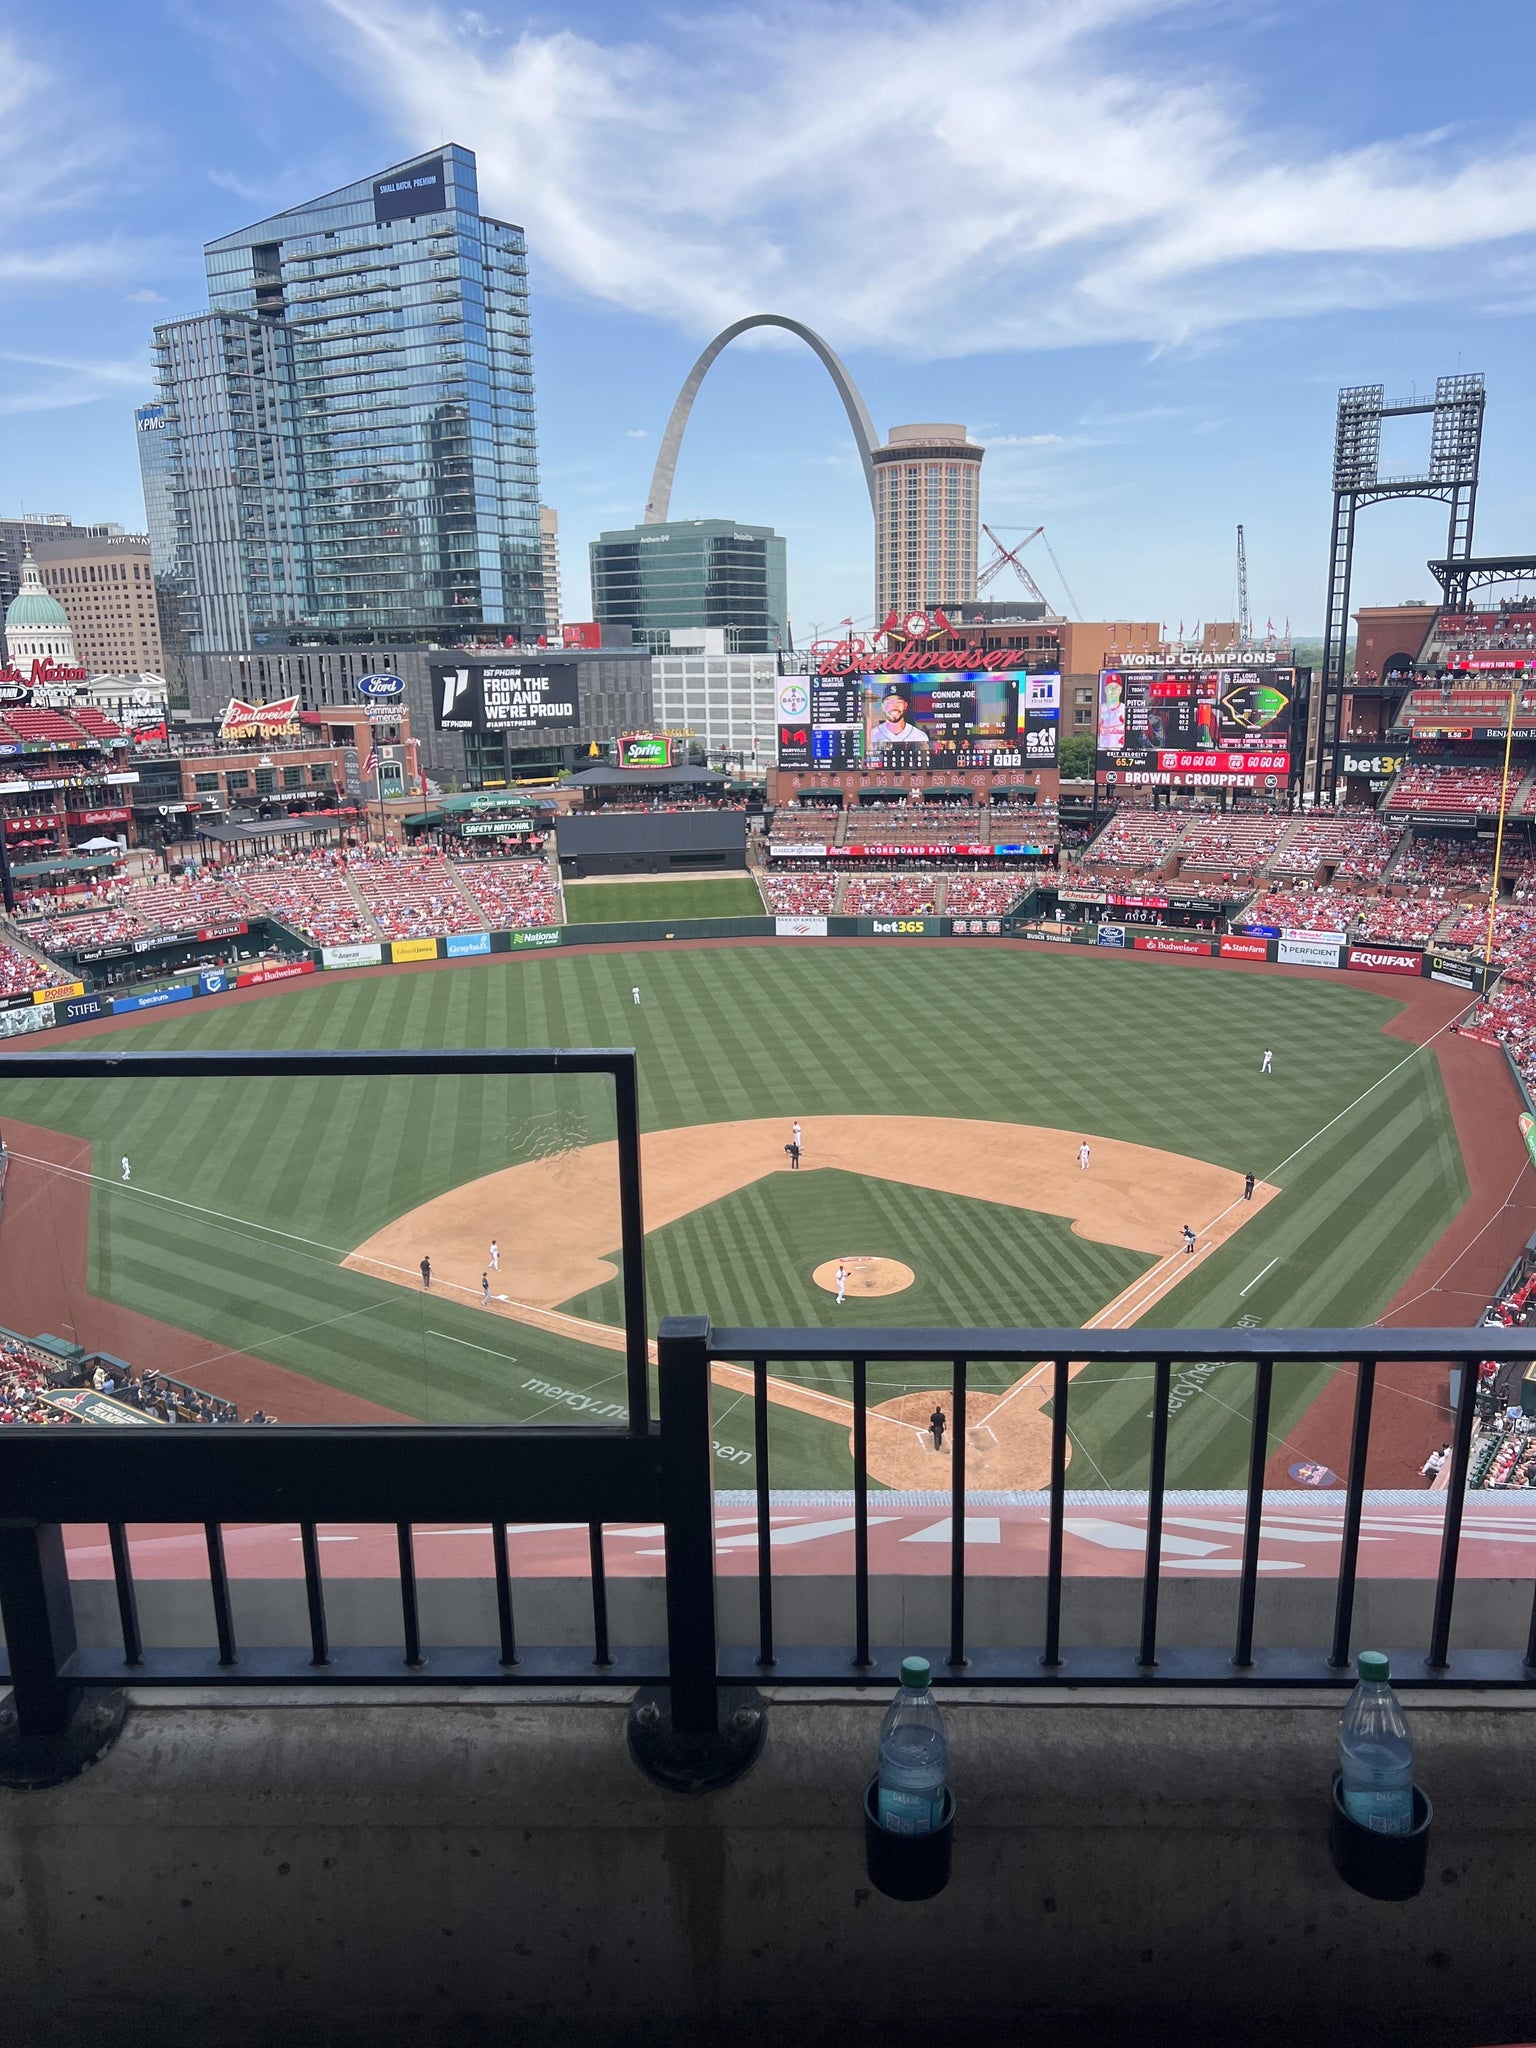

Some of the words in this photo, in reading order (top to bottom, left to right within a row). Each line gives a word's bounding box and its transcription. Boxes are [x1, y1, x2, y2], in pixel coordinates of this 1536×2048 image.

[380, 184, 396, 194] SMALL
[414, 176, 436, 187] PREMIUM
[138, 416, 164, 432] KPMG
[107, 537, 125, 545] HYATT
[811, 639, 1025, 676] Budweiser
[1120, 654, 1176, 666] WORLD
[1180, 652, 1276, 664] CHAMPIONS
[24, 656, 87, 687] Nation
[368, 677, 396, 692] Ford
[484, 679, 522, 691] FROM
[524, 678, 550, 690] THE
[33, 688, 77, 697] ROOFTOP
[485, 692, 512, 705] LOU
[513, 691, 541, 704] AND
[219, 708, 299, 724] Budweiser
[364, 706, 406, 716] Community
[485, 706, 523, 719] WE'RE
[526, 703, 572, 716] PROUD
[451, 720, 472, 728] PHORM
[222, 726, 257, 739] BREW
[260, 723, 300, 737] HOUSE
[628, 744, 661, 757] Sprite
[1180, 756, 1192, 766] GO
[1193, 756, 1203, 766] GO
[1205, 756, 1216, 766] GO
[1248, 757, 1258, 767] GO
[1260, 757, 1272, 767] GO
[1273, 757, 1284, 768] GO
[810, 778, 816, 787] 1
[821, 778, 828, 787] 2
[833, 778, 840, 787] 6
[846, 777, 854, 786] 9
[860, 777, 870, 786] 10
[877, 776, 887, 786] 14
[894, 776, 904, 786] 17
[910, 776, 924, 786] 20
[932, 776, 945, 786] 23
[952, 775, 965, 786] 24
[972, 775, 985, 785] 42
[992, 775, 1006, 785] 45
[1011, 774, 1024, 785] 85
[1125, 772, 1170, 784] BROWN
[1174, 776, 1181, 784] &
[1185, 773, 1254, 786] CROUPPEN
[466, 825, 493, 833] SAFETY
[494, 823, 530, 831] NATIONAL
[968, 846, 990, 854] Coca-Cola
[214, 926, 238, 935] PURINA
[873, 921, 924, 932] bet365
[1102, 927, 1119, 936] Ford
[524, 931, 558, 942] National
[1158, 942, 1198, 952] Budweiser
[1290, 947, 1337, 956] PERFICIENT
[1350, 952, 1415, 968] EQUIFAX
[201, 969, 224, 978] CarShield
[264, 968, 302, 981] Budweiser
[45, 986, 74, 997] DOBBS
[139, 995, 167, 1006] Spectrum
[68, 1002, 101, 1017] STIFEL
